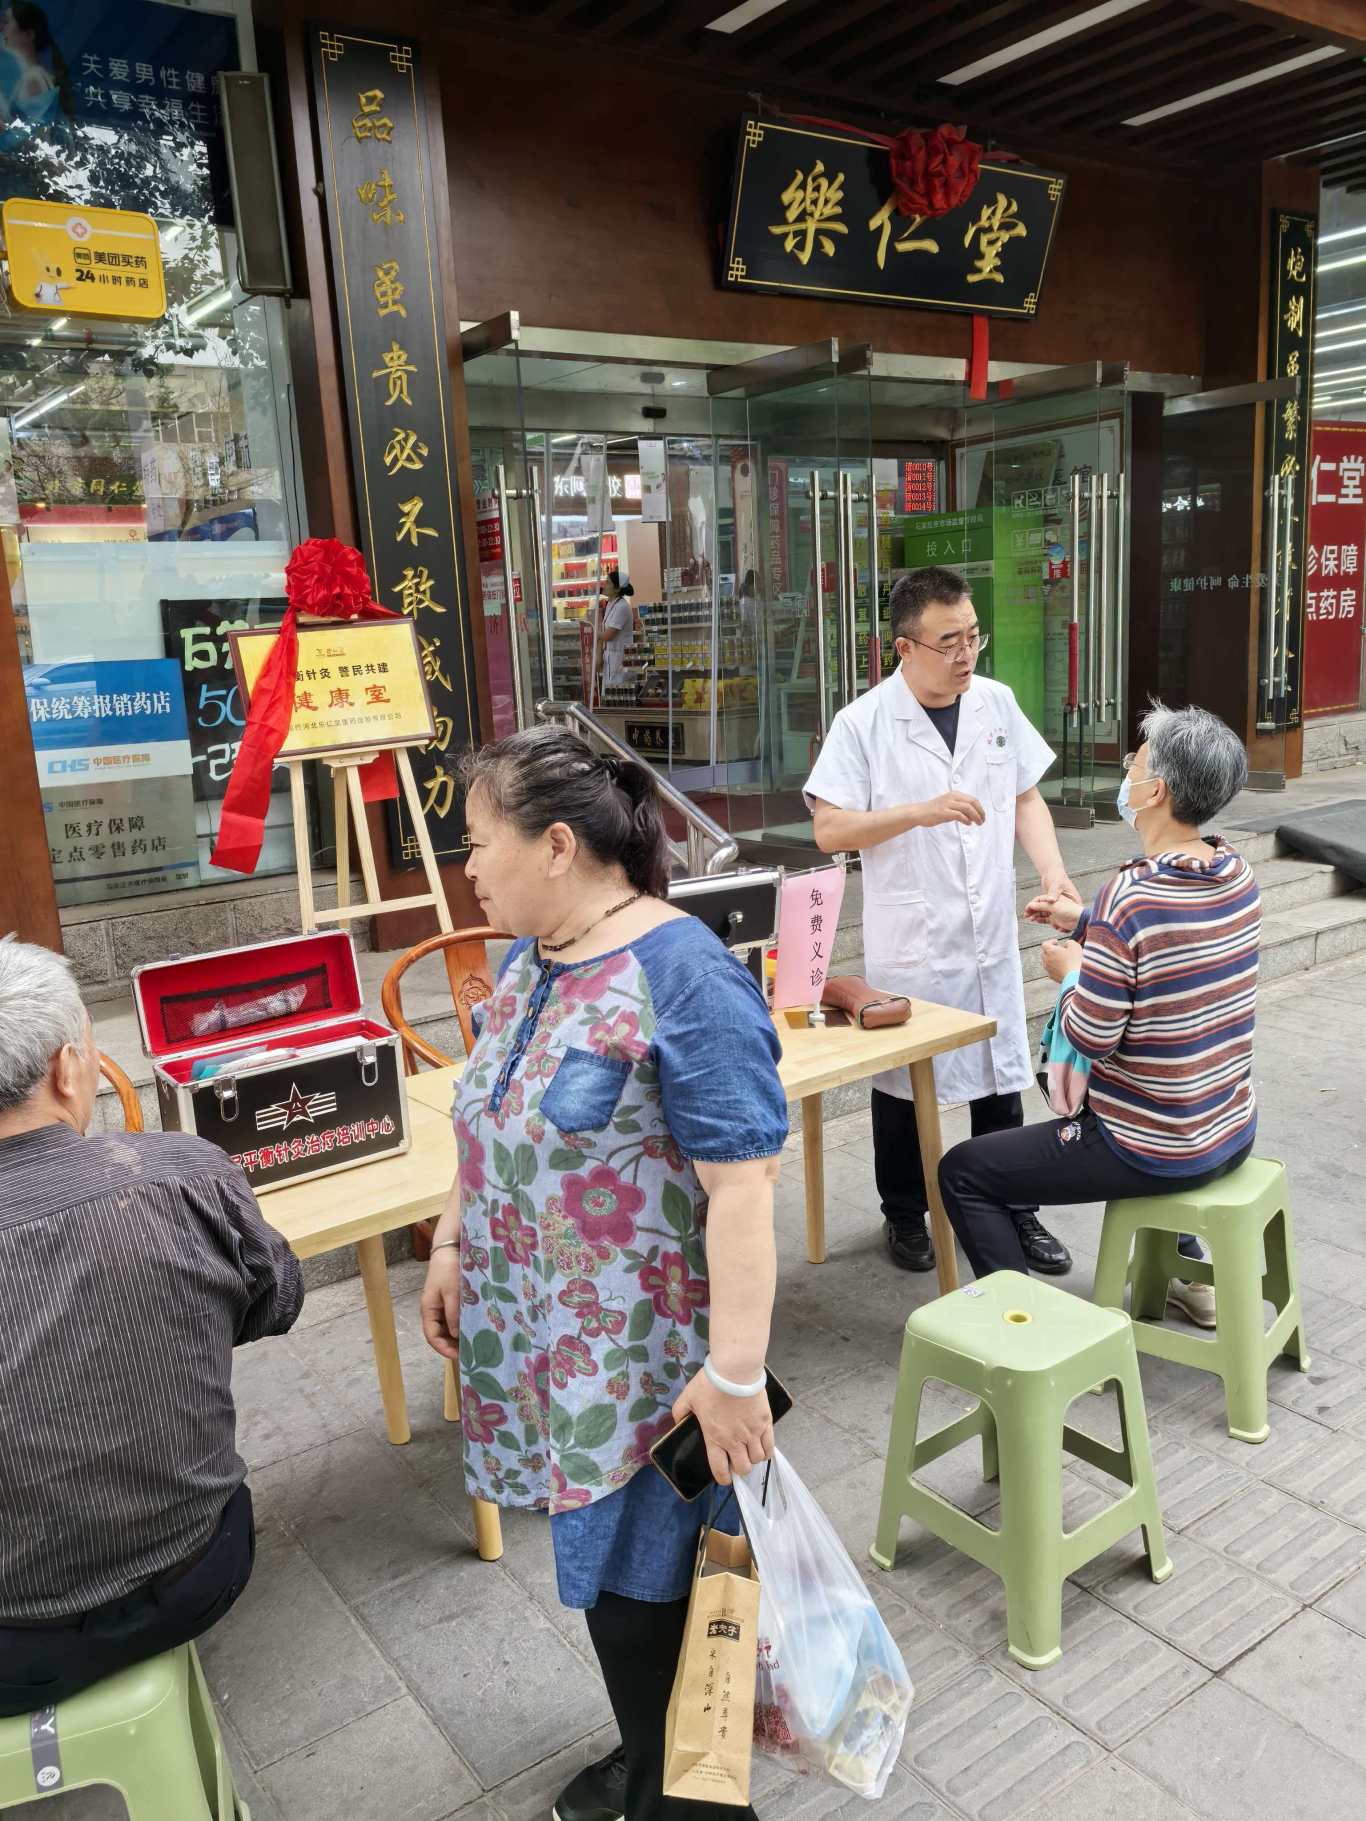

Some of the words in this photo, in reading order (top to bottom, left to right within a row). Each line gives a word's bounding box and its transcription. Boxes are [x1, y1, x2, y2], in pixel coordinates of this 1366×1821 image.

[83, 85, 220, 124] 共享幸福生
[768, 159, 1028, 284] 樂仁堂
[94, 251, 148, 269] 美团买药
[1311, 455, 1365, 505] 仁堂
[338, 662, 390, 678] 警民共建
[30, 690, 171, 722] 保统筹报销药店
[293, 684, 391, 713] 健康室
[64, 815, 147, 840] 医疗保障
[51, 836, 168, 864] 定点零售药店
[809, 888, 824, 988] 免费义诊
